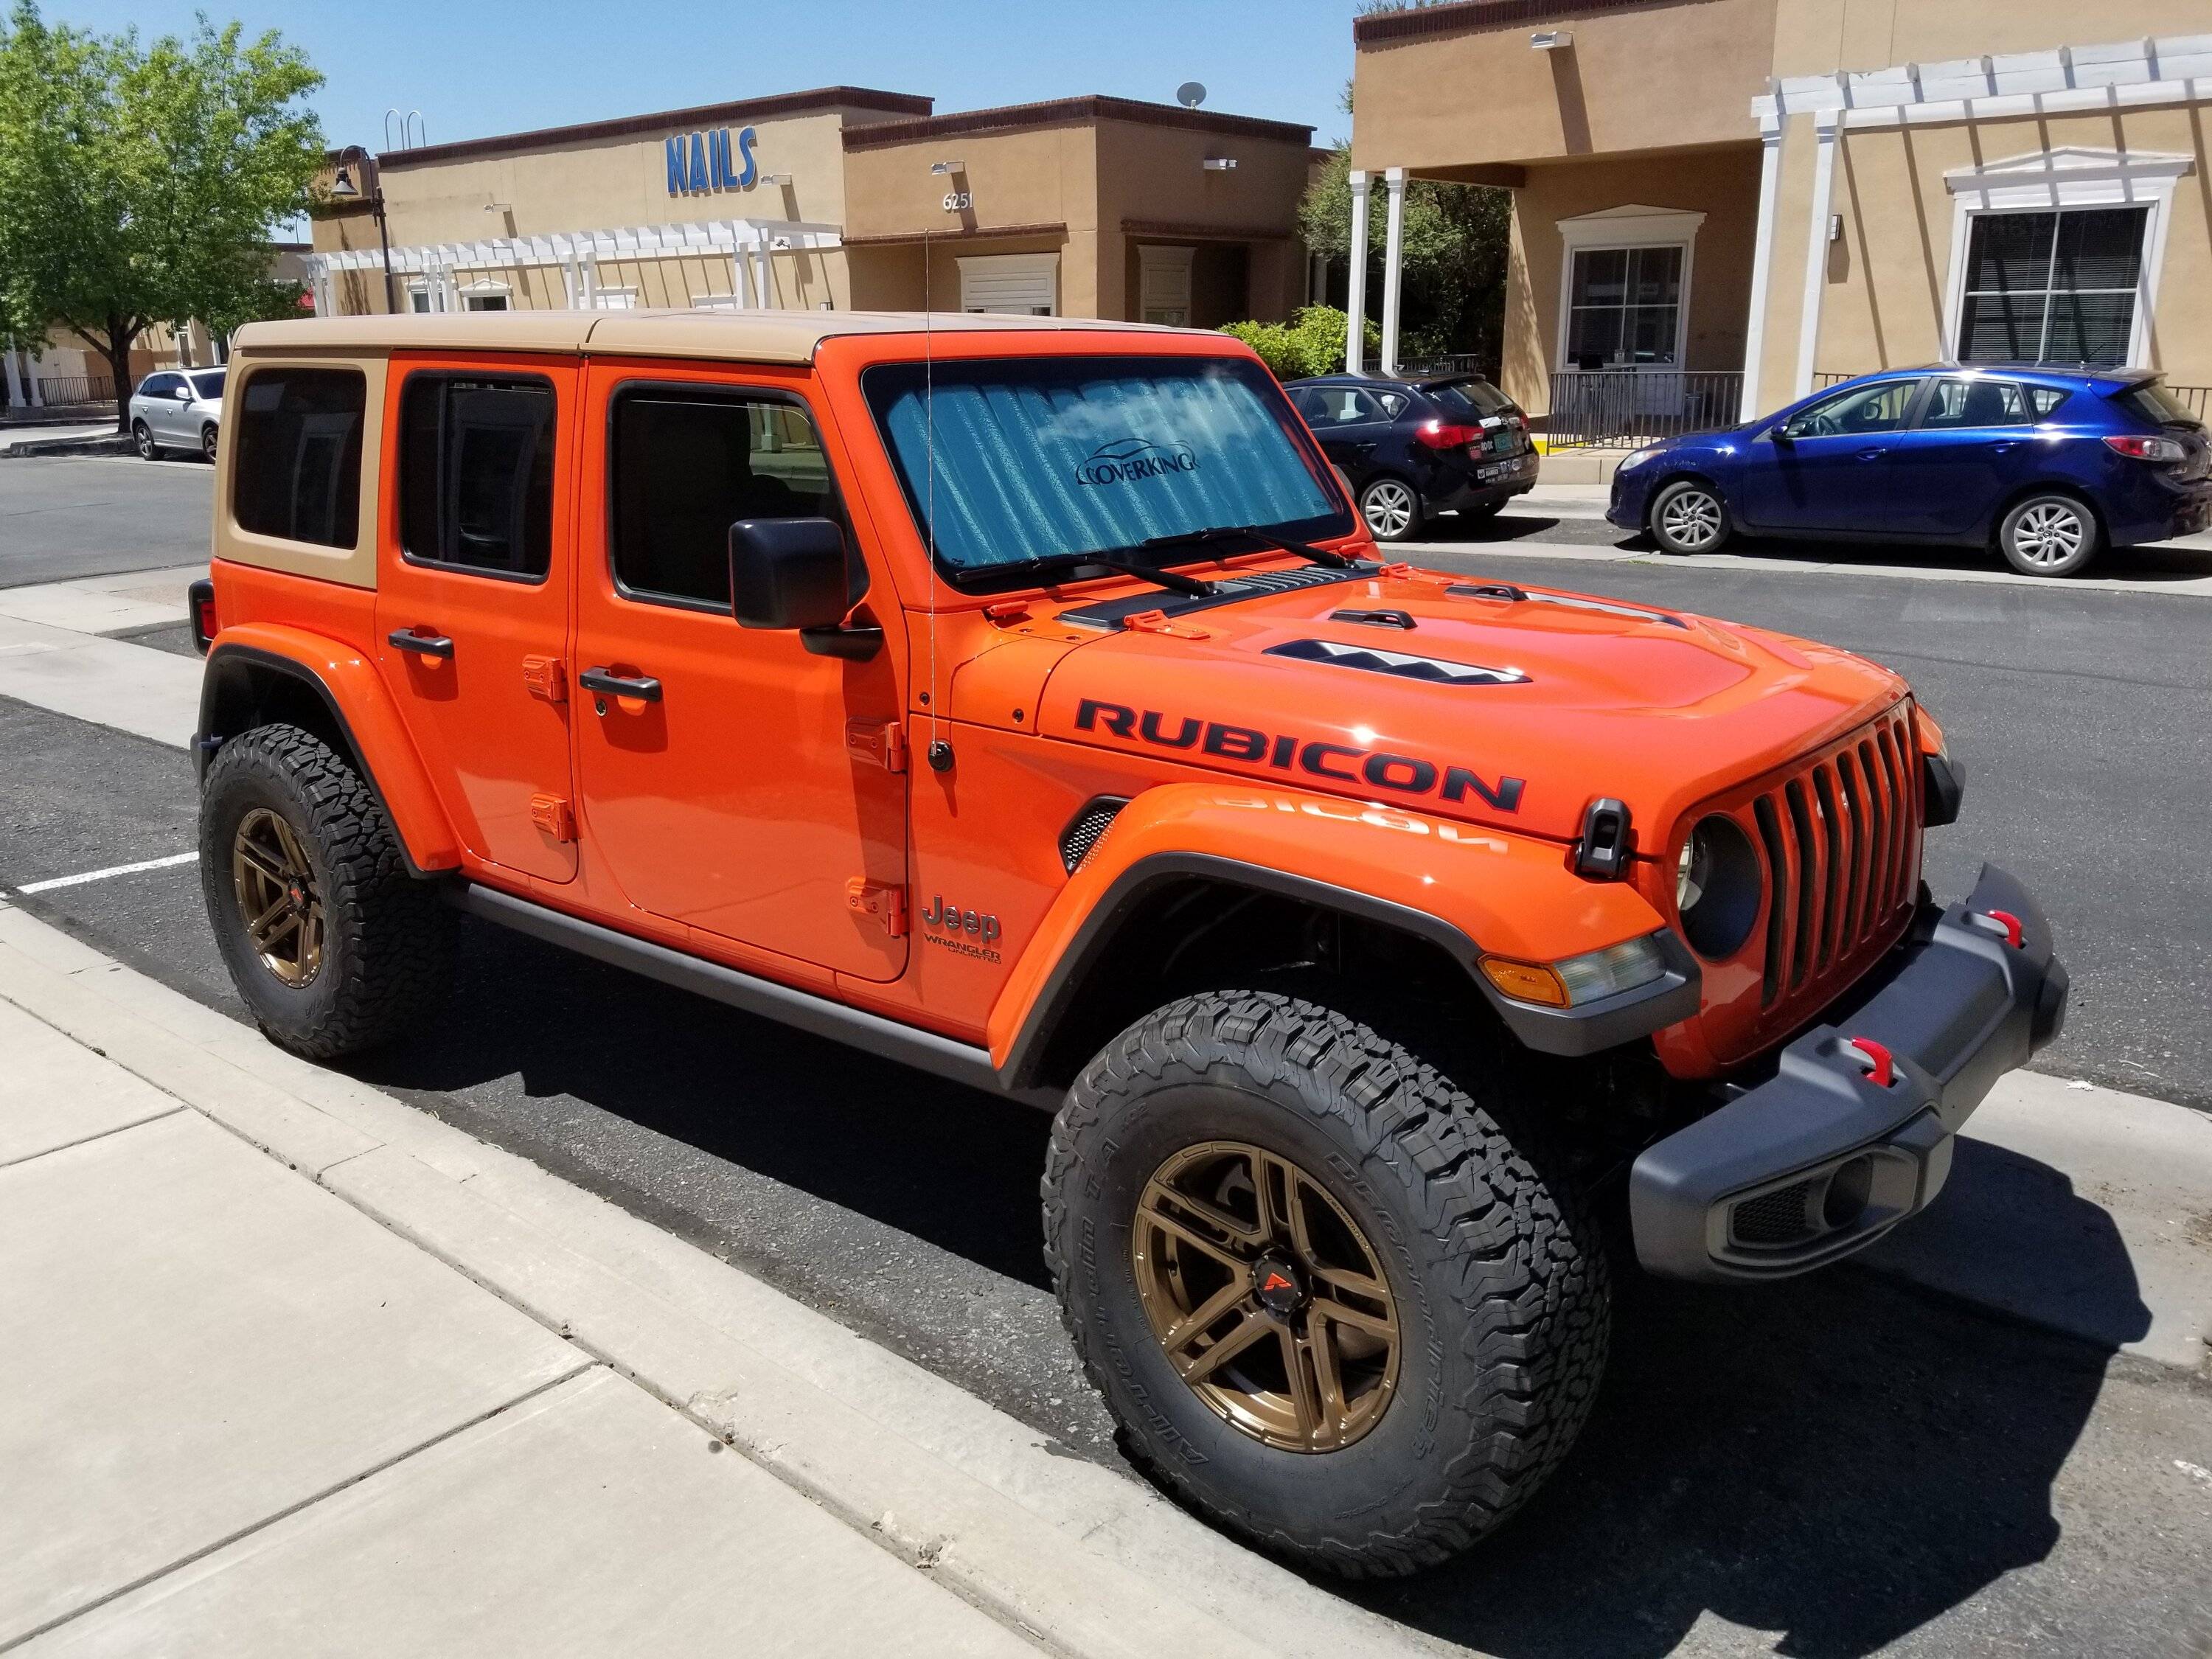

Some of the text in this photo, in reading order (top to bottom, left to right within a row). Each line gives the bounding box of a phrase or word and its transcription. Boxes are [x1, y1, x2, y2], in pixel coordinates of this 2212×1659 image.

[665, 125, 756, 194] NAILS
[943, 192, 973, 210] 6251
[1086, 453, 1194, 485] COVERKING
[1074, 698, 1527, 814] RUBICON
[922, 894, 1000, 945] Jeep
[924, 932, 1001, 960] WRANGLER
[947, 947, 1002, 964] UNLIMITED
